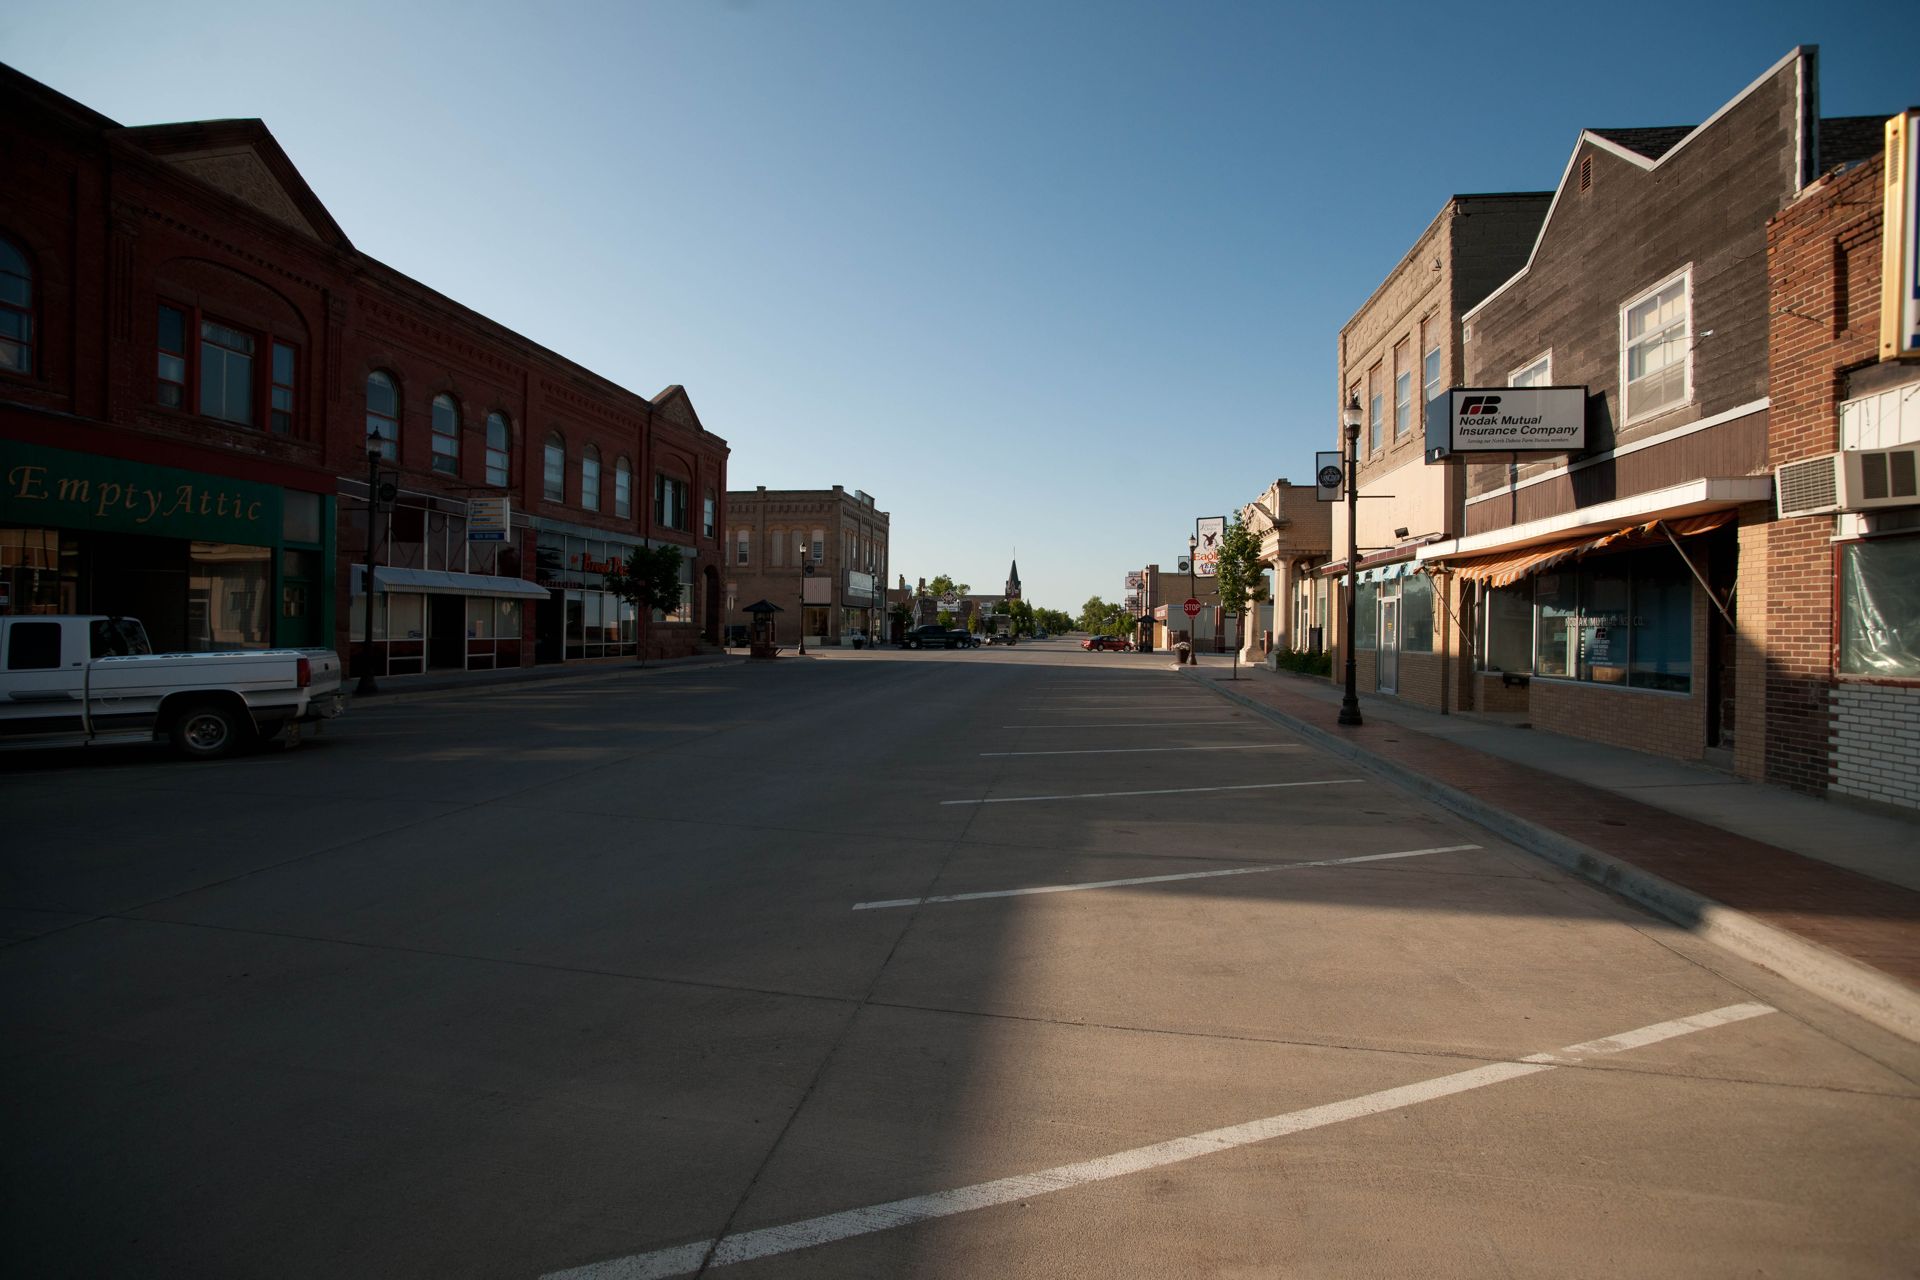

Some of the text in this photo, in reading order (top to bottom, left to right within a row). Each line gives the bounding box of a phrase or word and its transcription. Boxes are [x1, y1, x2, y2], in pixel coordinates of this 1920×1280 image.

[1460, 416, 1543, 426] Nodak Mutual
[1460, 426, 1578, 437] Insurance Company
[1184, 603, 1200, 611] STOP
